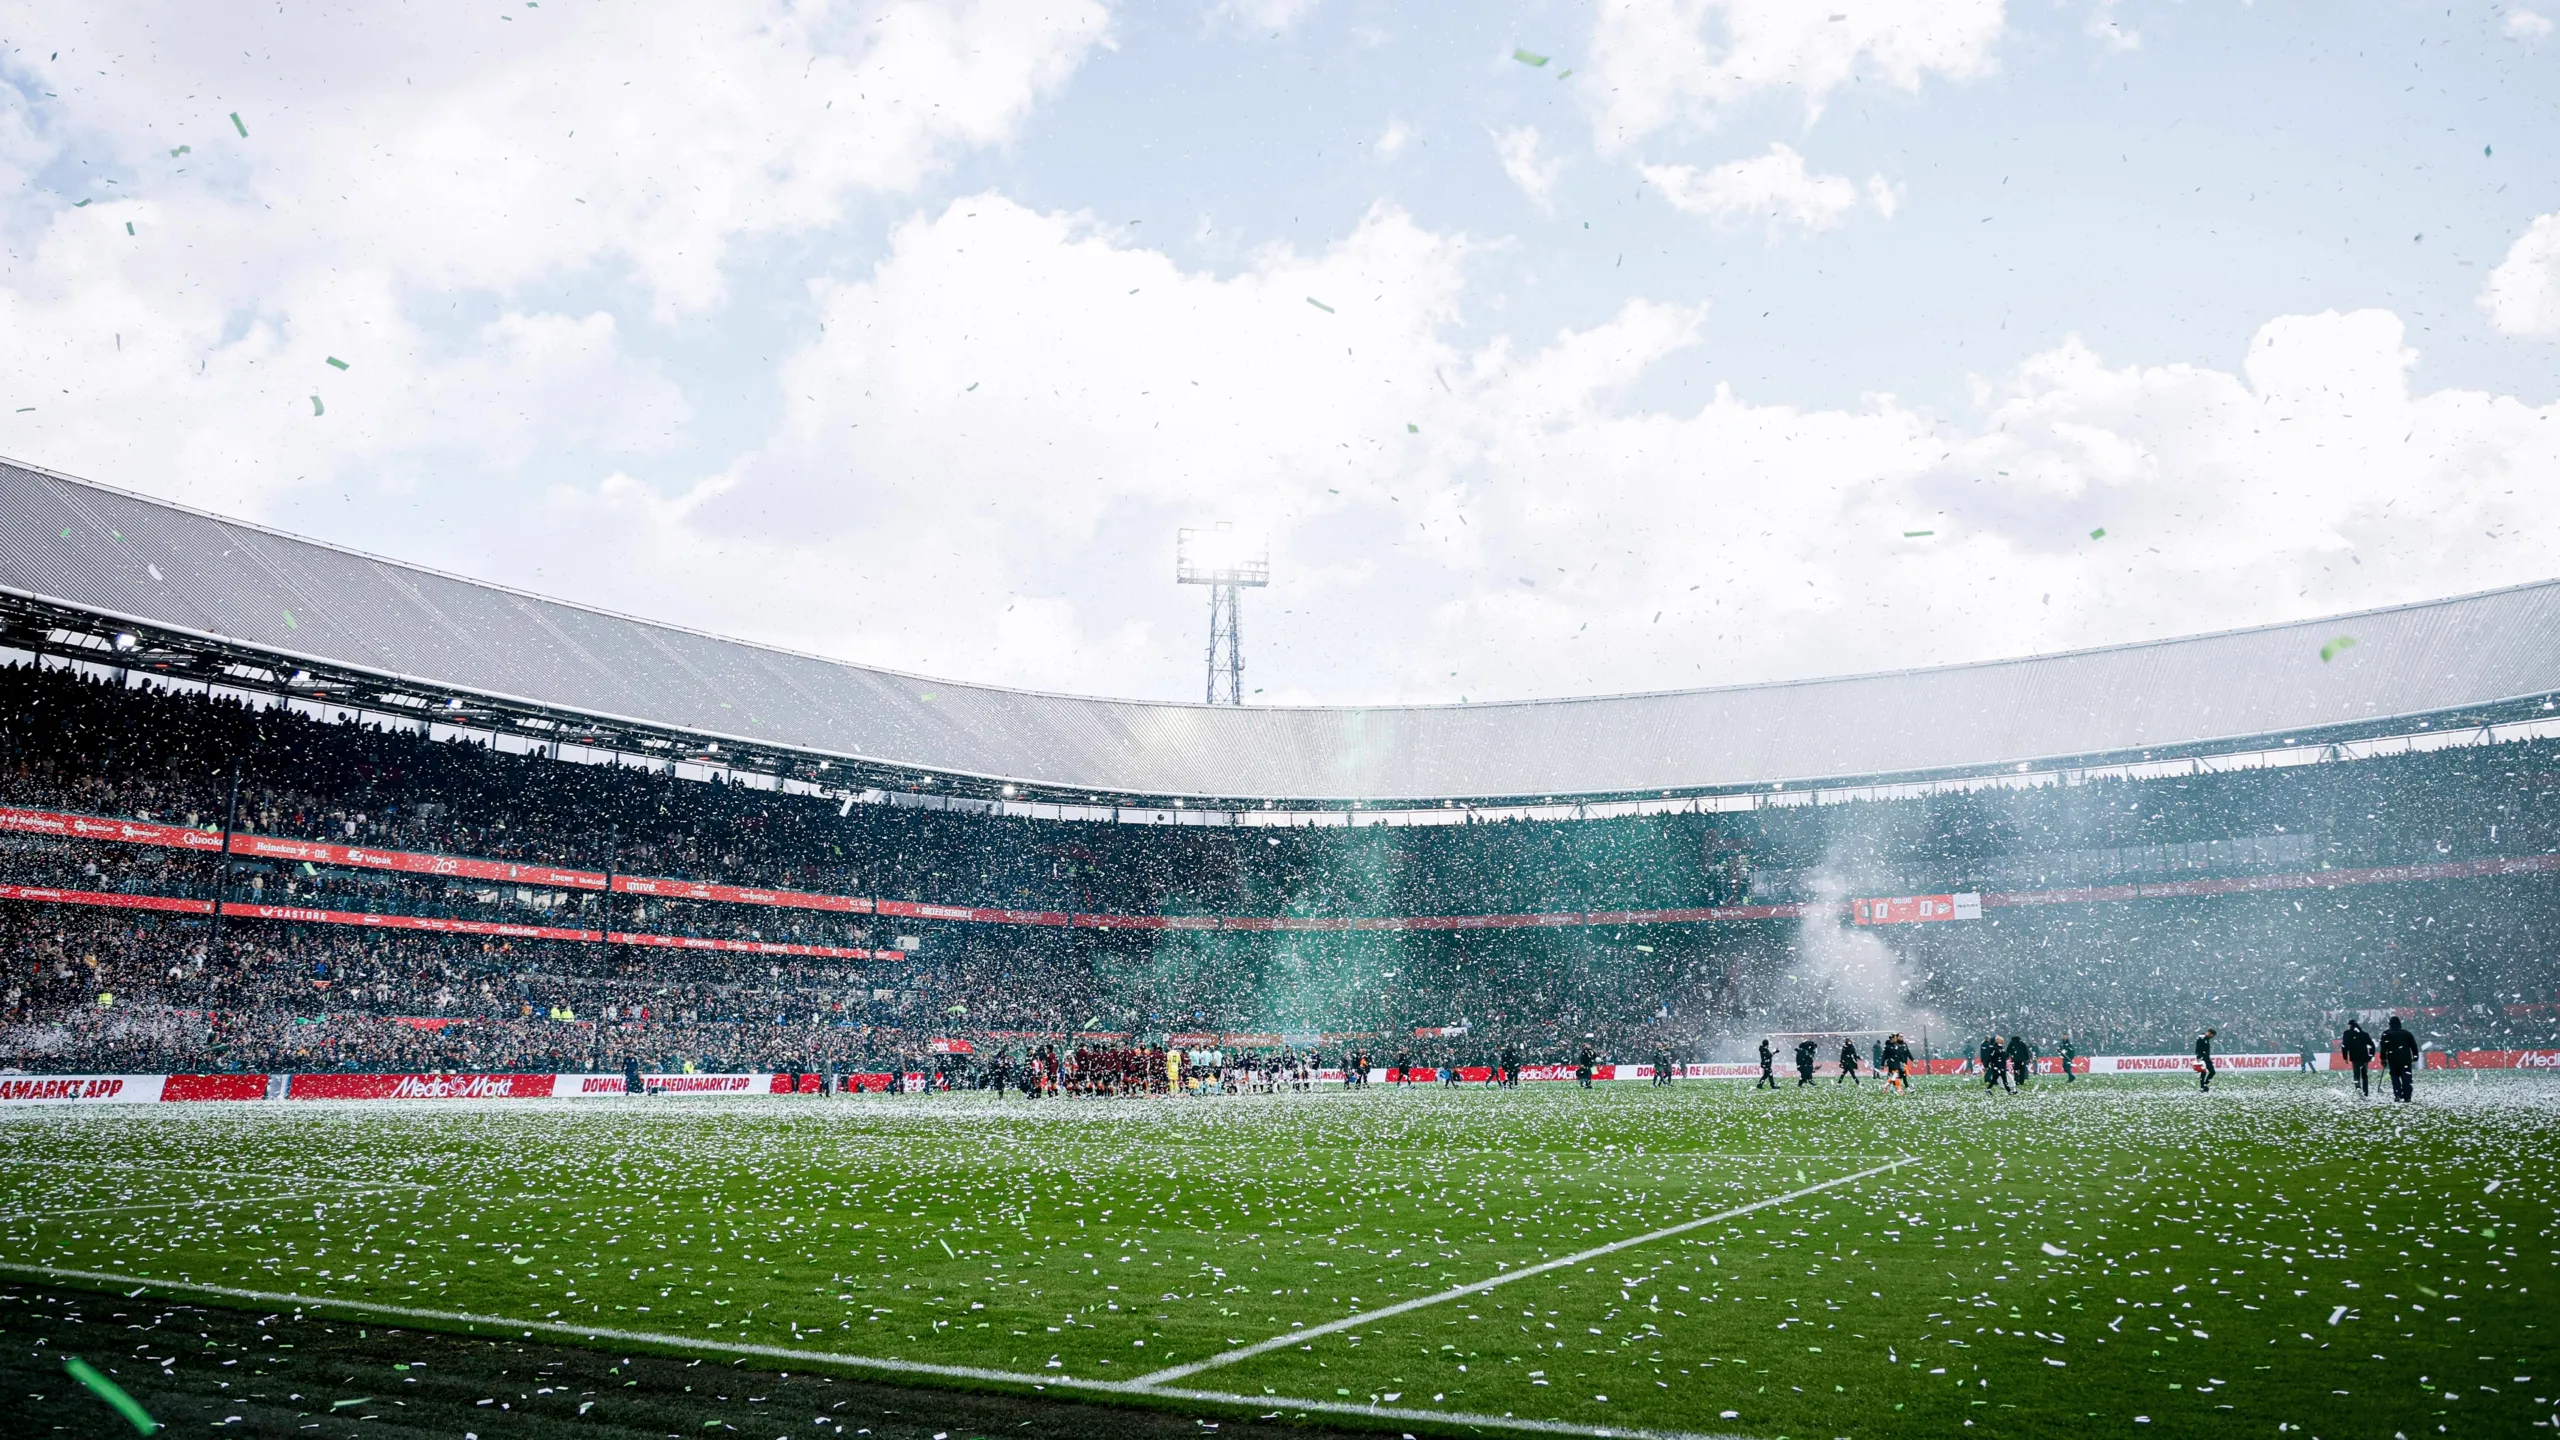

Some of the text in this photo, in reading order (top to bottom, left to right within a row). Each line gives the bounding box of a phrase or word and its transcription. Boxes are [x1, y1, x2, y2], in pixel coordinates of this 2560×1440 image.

[183, 832, 224, 846] Quooke
[256, 841, 297, 855] Heineken
[365, 854, 392, 865] Vopak
[626, 880, 656, 892] univé
[276, 908, 327, 921] CASTORE
[2117, 1058, 2180, 1070] DOWNLOAD
[2279, 1056, 2302, 1068] APP
[1518, 1066, 1577, 1080] edia Mar
[1690, 1066, 1701, 1077] DE
[1702, 1065, 1761, 1077] MEDIAMARK
[84, 1079, 123, 1098] APP
[391, 1076, 513, 1097] Media Markt
[661, 1078, 729, 1092] MEDIAMARKT
[730, 1078, 750, 1091] APP
